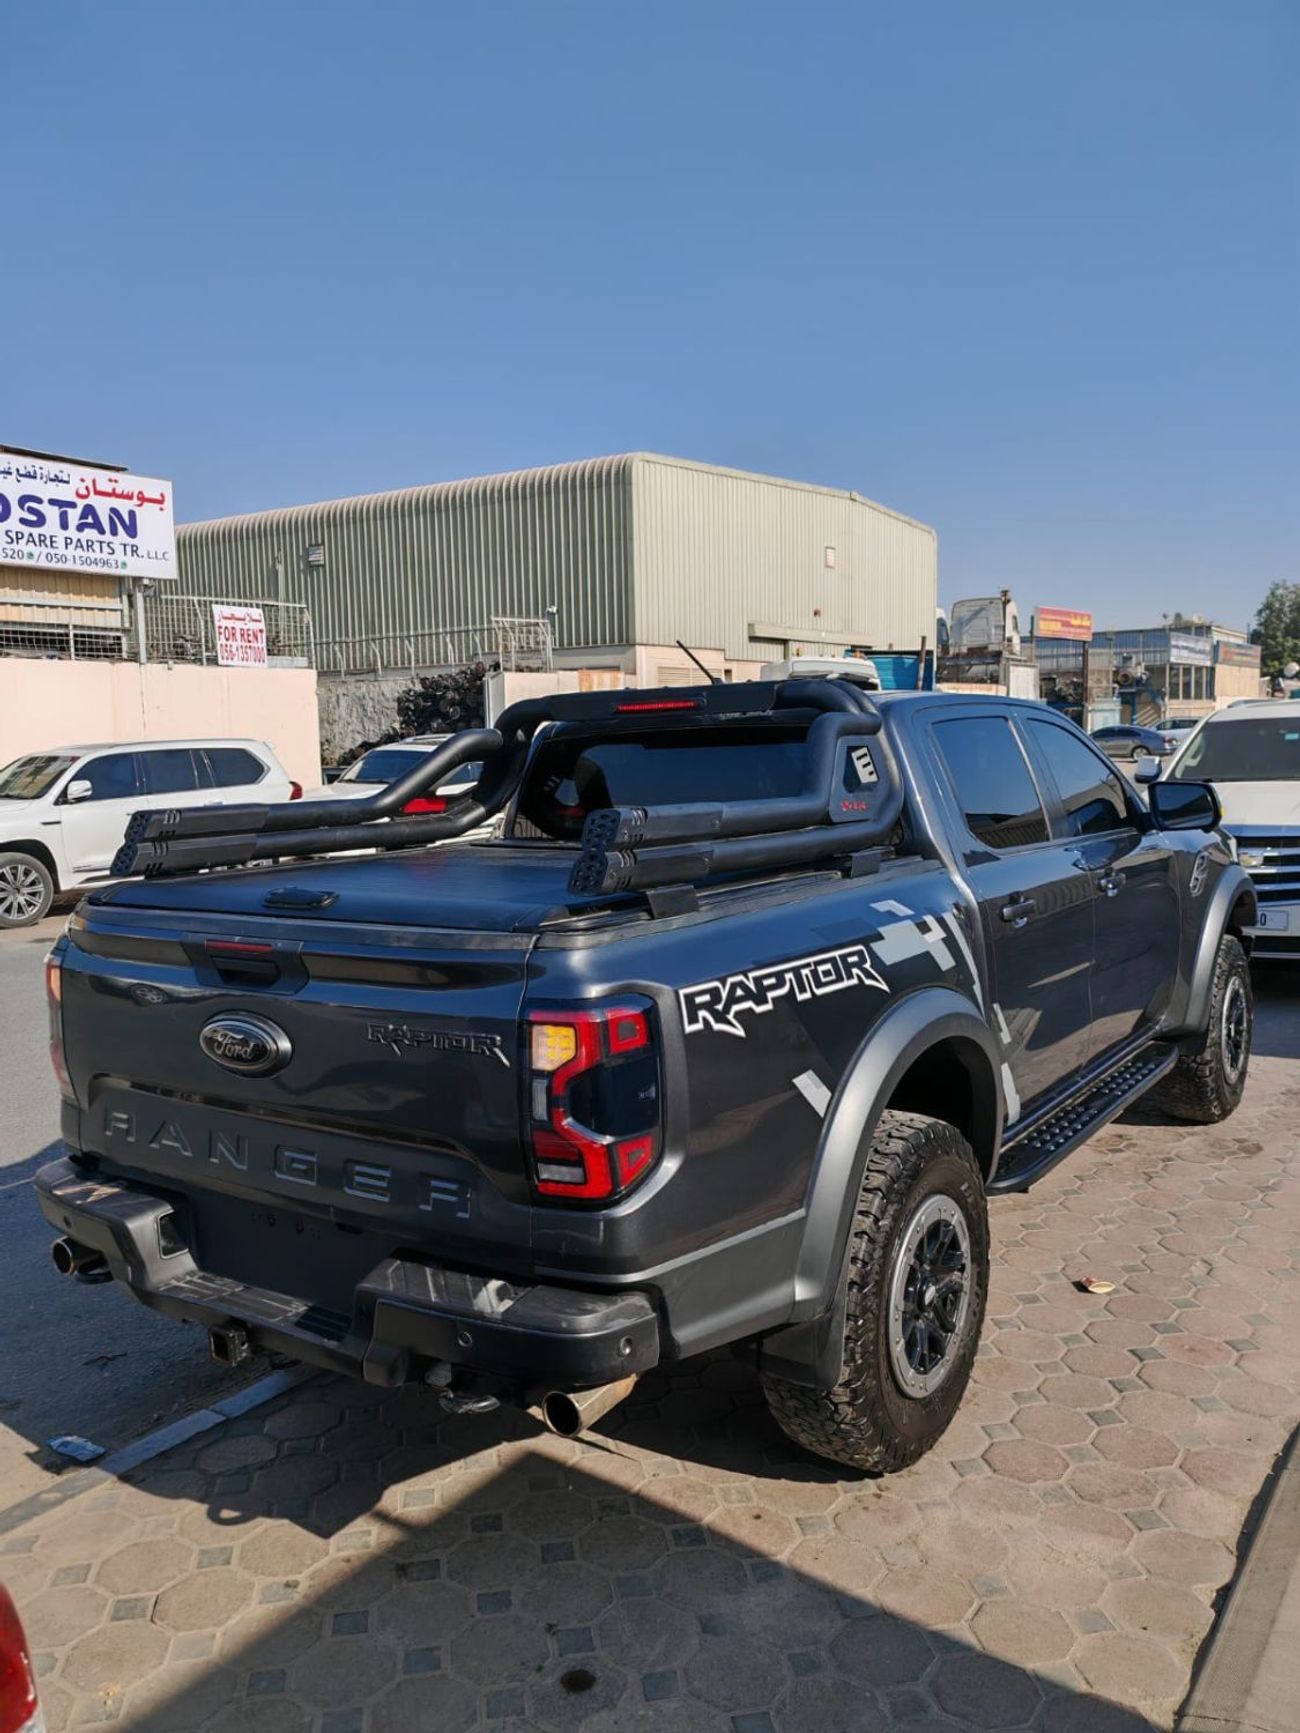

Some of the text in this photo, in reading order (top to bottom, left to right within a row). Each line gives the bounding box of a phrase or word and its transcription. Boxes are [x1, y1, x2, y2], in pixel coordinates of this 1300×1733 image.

[15, 464, 37, 483] قطع
[75, 478, 165, 511] بوستان
[4, 529, 59, 549] SPARE
[64, 536, 116, 556] PARTS
[119, 543, 145, 559] TR.
[45, 552, 119, 569] 050-1504963
[217, 625, 264, 645] FOR RENT
[677, 944, 890, 1037] RAPTOR
[205, 1027, 255, 1062] Ford
[366, 1022, 511, 1068] RAPTOR
[103, 1102, 473, 1219] RANGER
